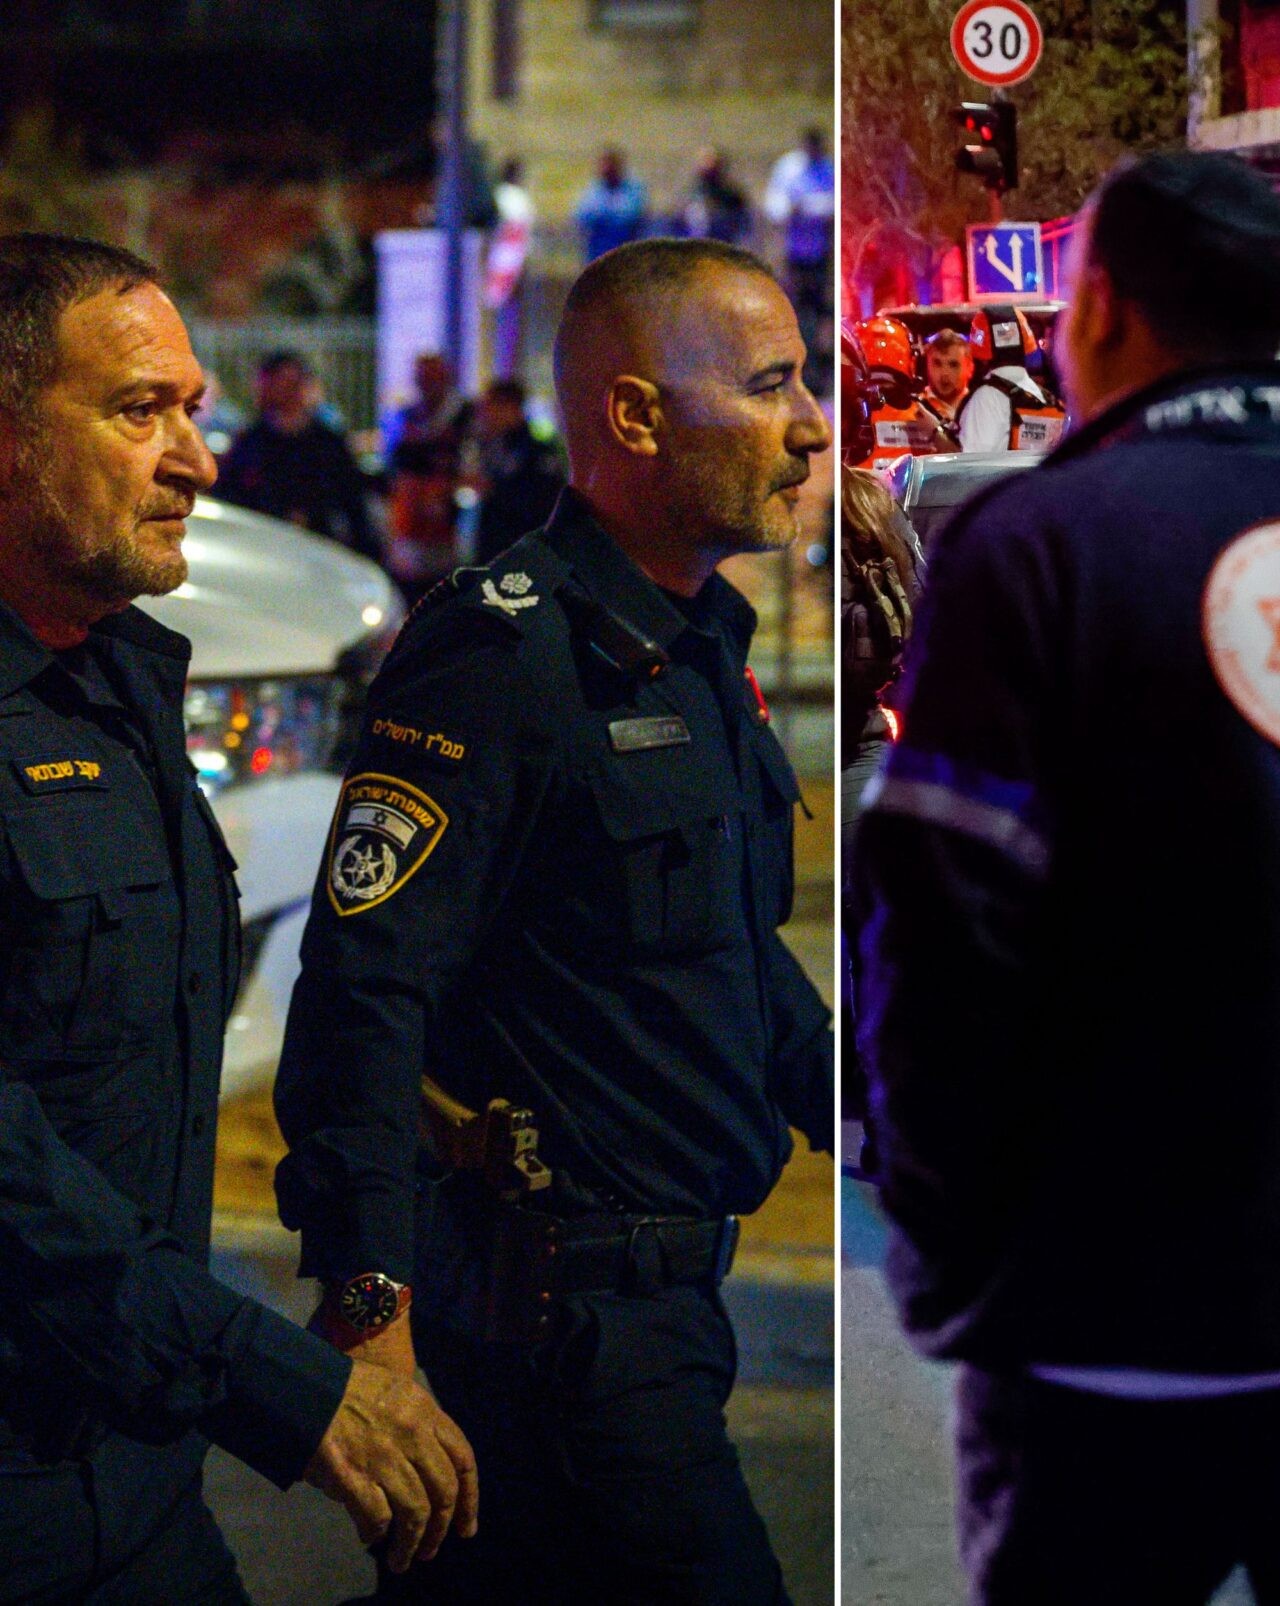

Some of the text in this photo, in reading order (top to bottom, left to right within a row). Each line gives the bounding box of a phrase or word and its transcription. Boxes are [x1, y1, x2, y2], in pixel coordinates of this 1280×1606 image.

[972, 21, 1021, 60] 30
[372, 718, 422, 744] ירושלים
[386, 791, 436, 830] משטרת
